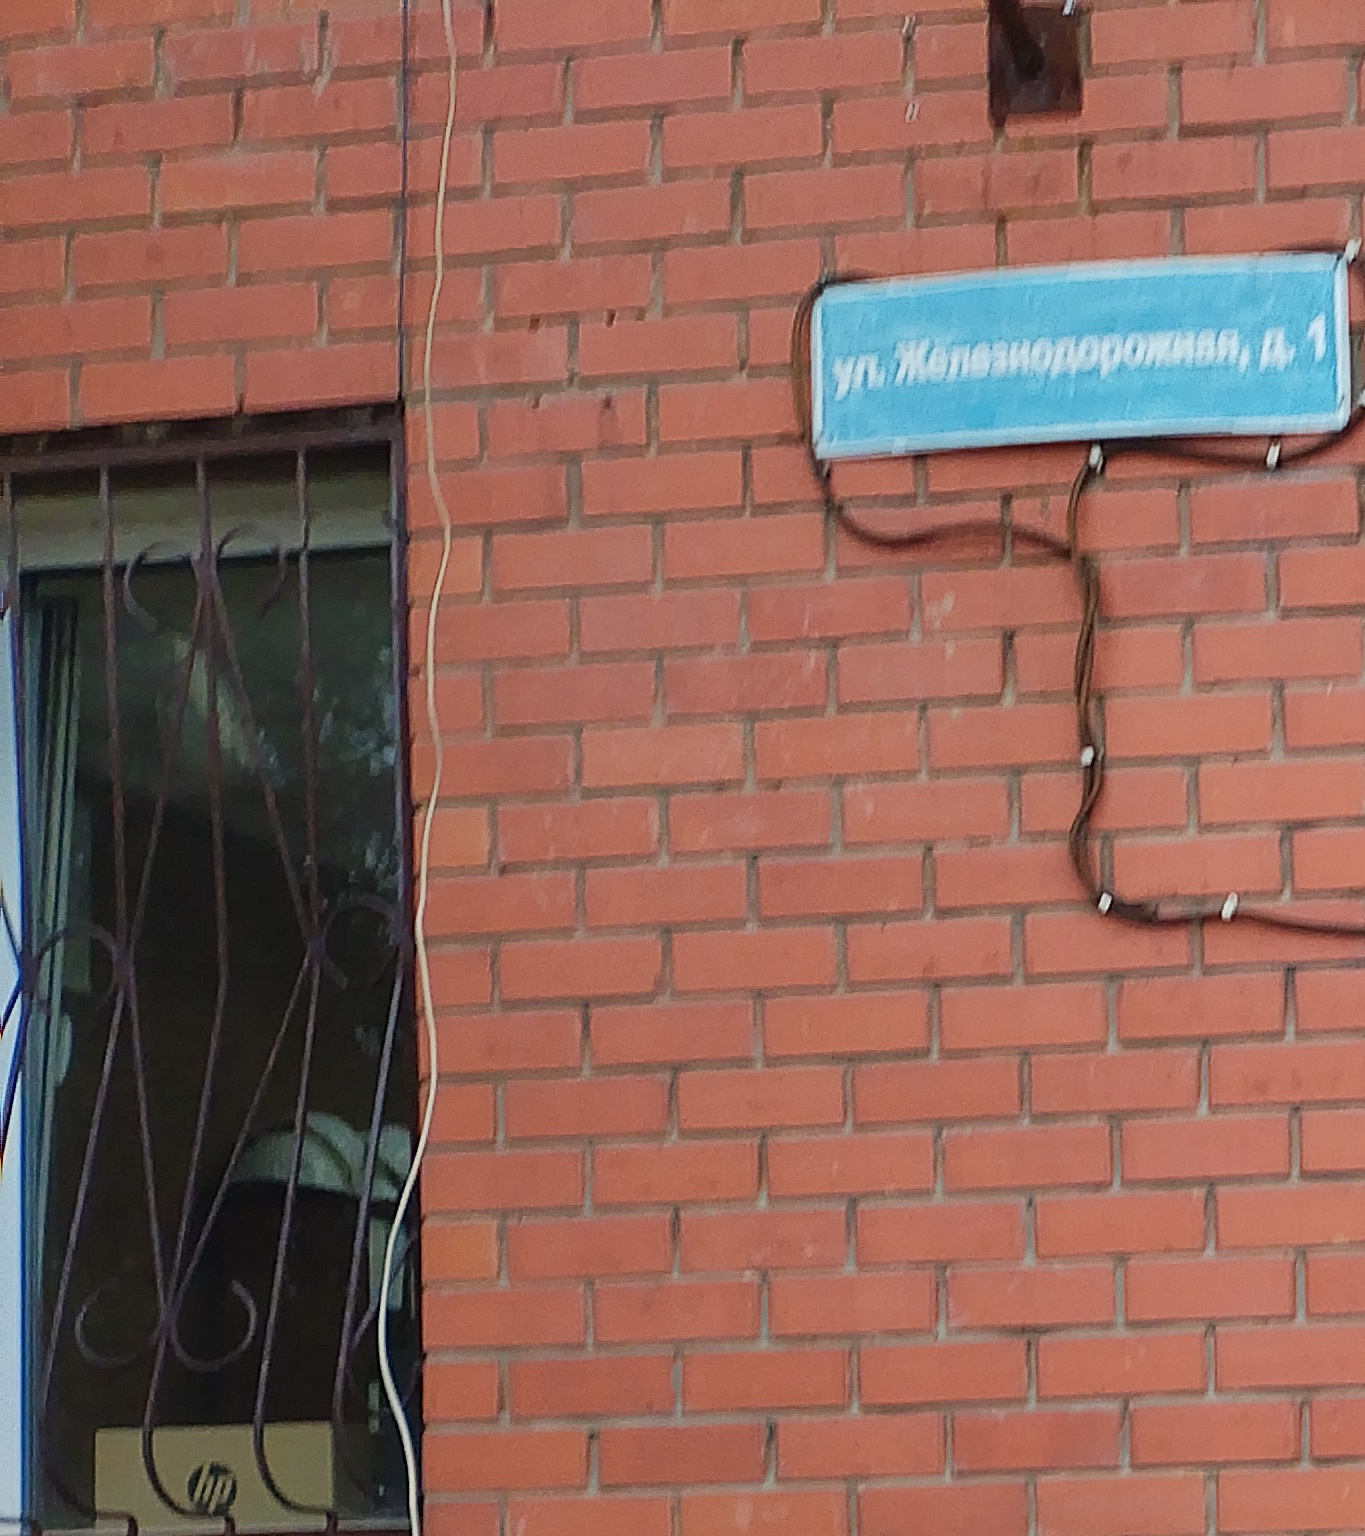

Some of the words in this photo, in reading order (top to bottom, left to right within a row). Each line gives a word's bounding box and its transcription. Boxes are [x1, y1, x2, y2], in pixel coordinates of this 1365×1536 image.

[834, 354, 886, 401] ул.
[1259, 326, 1296, 374] д.
[1307, 312, 1326, 362] 1
